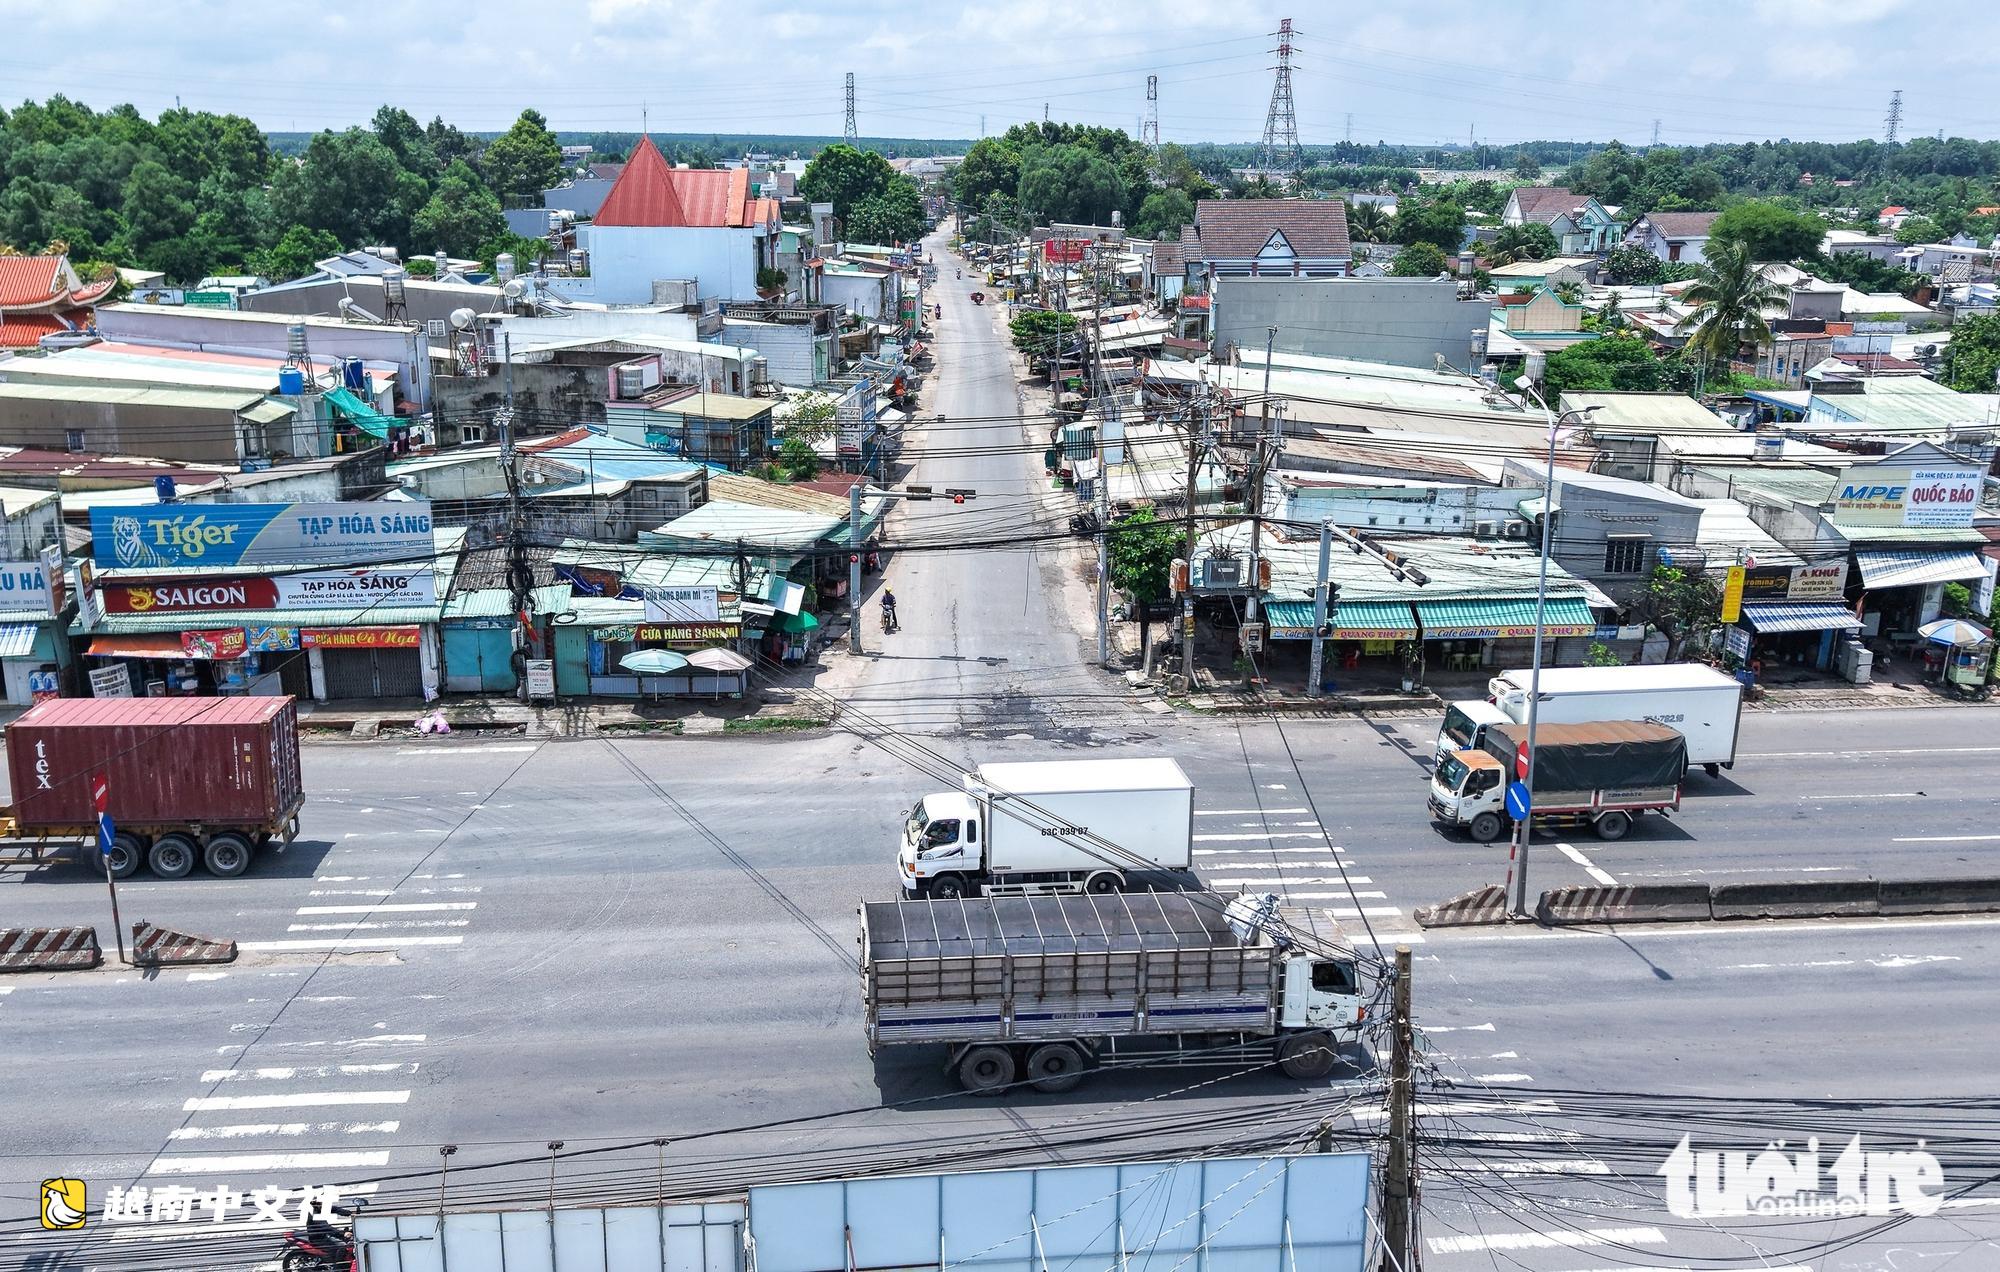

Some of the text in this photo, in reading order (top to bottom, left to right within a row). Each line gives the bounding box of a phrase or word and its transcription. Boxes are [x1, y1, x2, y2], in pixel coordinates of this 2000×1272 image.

[1840, 485, 1907, 500] MPE
[1912, 482, 1975, 504] QUỐC BẢO
[297, 512, 431, 540] TẠP HÓA SÁNG
[148, 514, 239, 558] Tiger
[0, 566, 15, 591] U
[1799, 567, 1841, 578] A KHUÊ
[301, 573, 408, 594] TẠP HÓA SÁNG
[155, 586, 247, 607] SAIGON
[399, 590, 411, 598] CÁC
[675, 589, 692, 601] BÁNH
[692, 588, 701, 600] MÌ
[333, 631, 355, 645] HÀNG
[357, 630, 377, 644] Cô
[380, 631, 417, 647] Nga
[640, 624, 739, 640] CỬA HÀNG BÁNH MÌ
[1340, 631, 1376, 639] QUANG
[1507, 626, 1547, 637] QUAG
[222, 634, 242, 646] 300
[34, 739, 52, 790] tex
